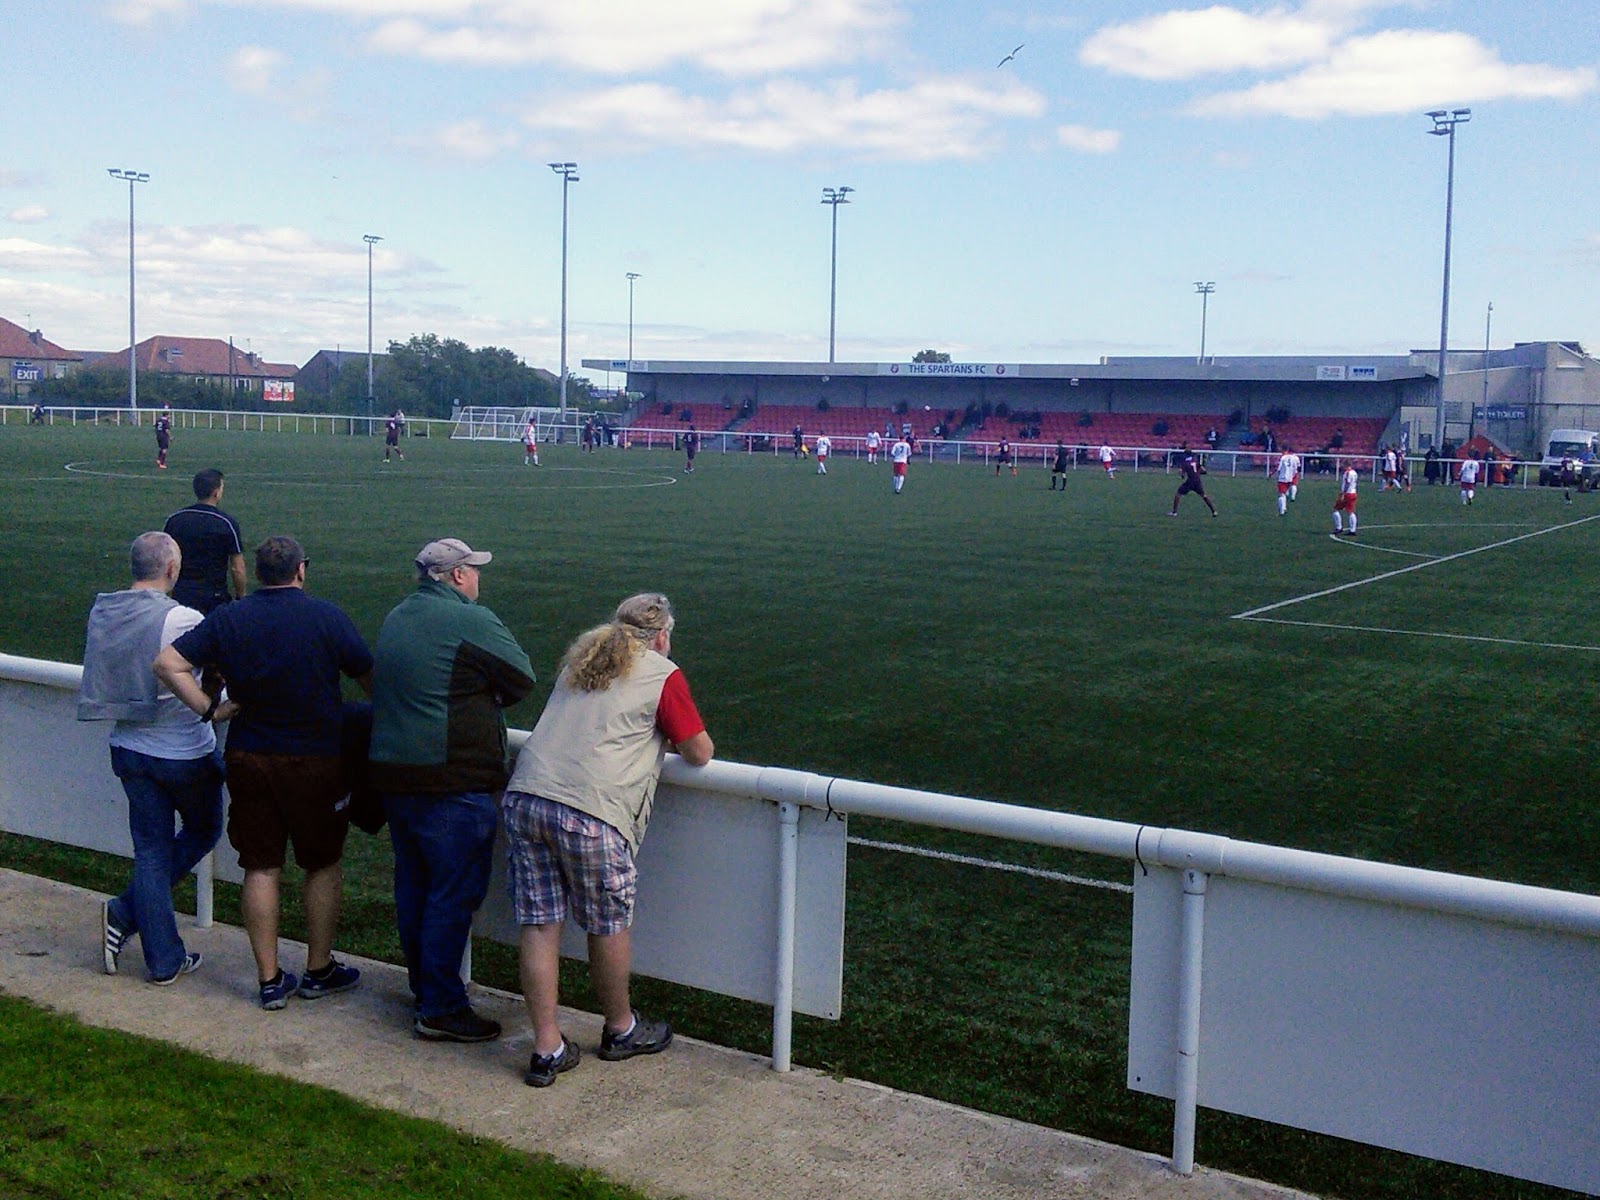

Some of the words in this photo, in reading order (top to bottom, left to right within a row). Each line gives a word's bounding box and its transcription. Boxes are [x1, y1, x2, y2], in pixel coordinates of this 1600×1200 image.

[909, 364, 925, 373] THE
[928, 365, 973, 374] SPARTANS
[975, 365, 986, 374] FC
[17, 369, 39, 380] EXIT
[157, 421, 163, 431] 2
